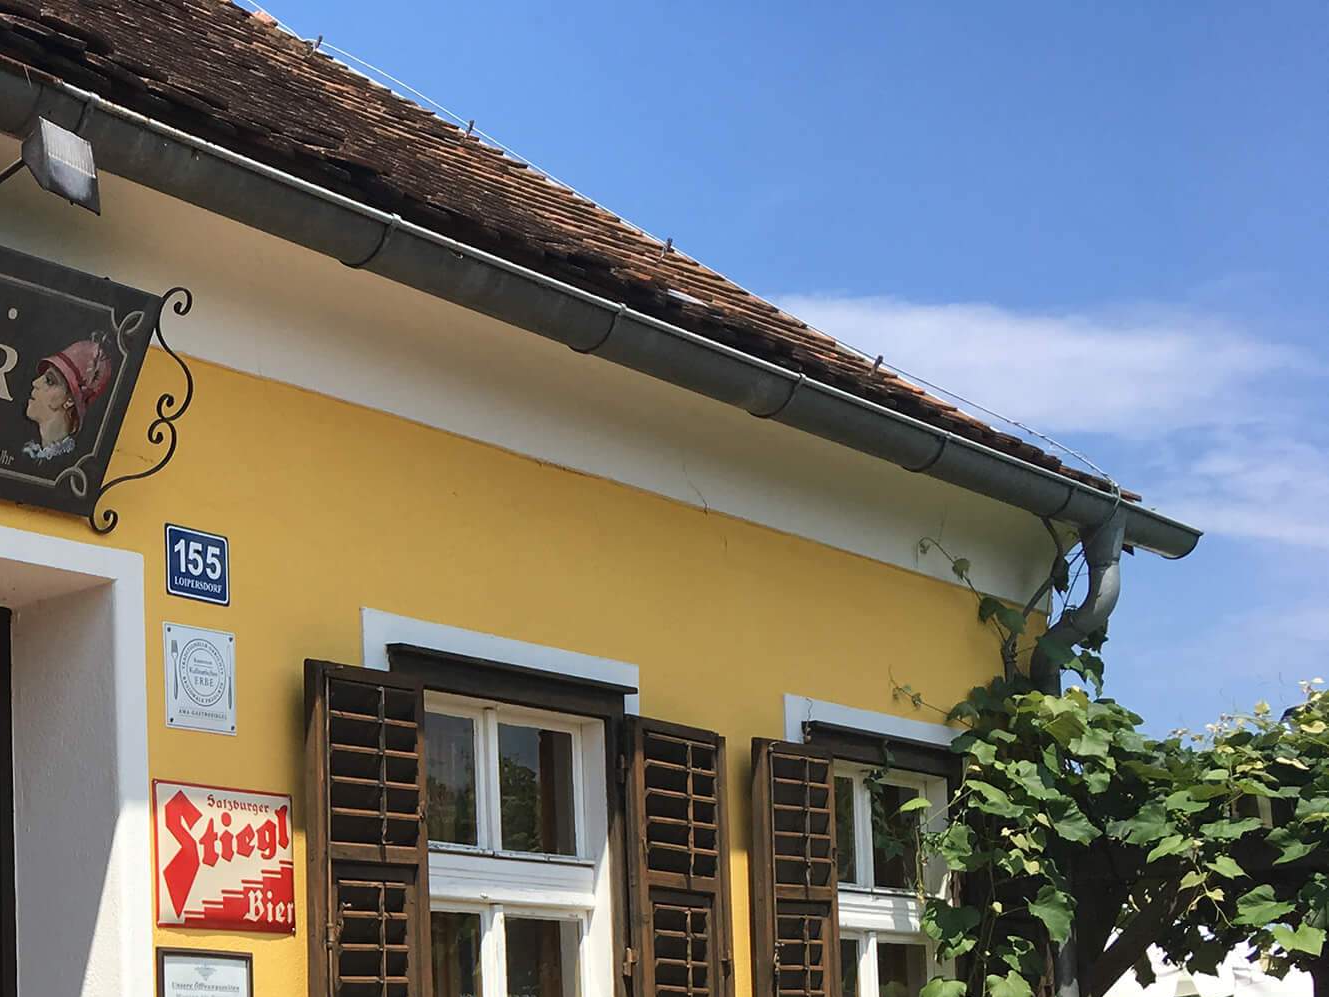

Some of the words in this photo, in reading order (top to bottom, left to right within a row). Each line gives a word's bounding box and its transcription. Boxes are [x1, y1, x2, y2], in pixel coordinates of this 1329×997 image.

[174, 538, 222, 581] 155
[174, 575, 222, 594] LOIPERSDORF
[194, 675, 214, 687] ERBE
[207, 794, 270, 815] Salzburger
[163, 790, 290, 919] Stiegl
[243, 890, 294, 924] Bier
